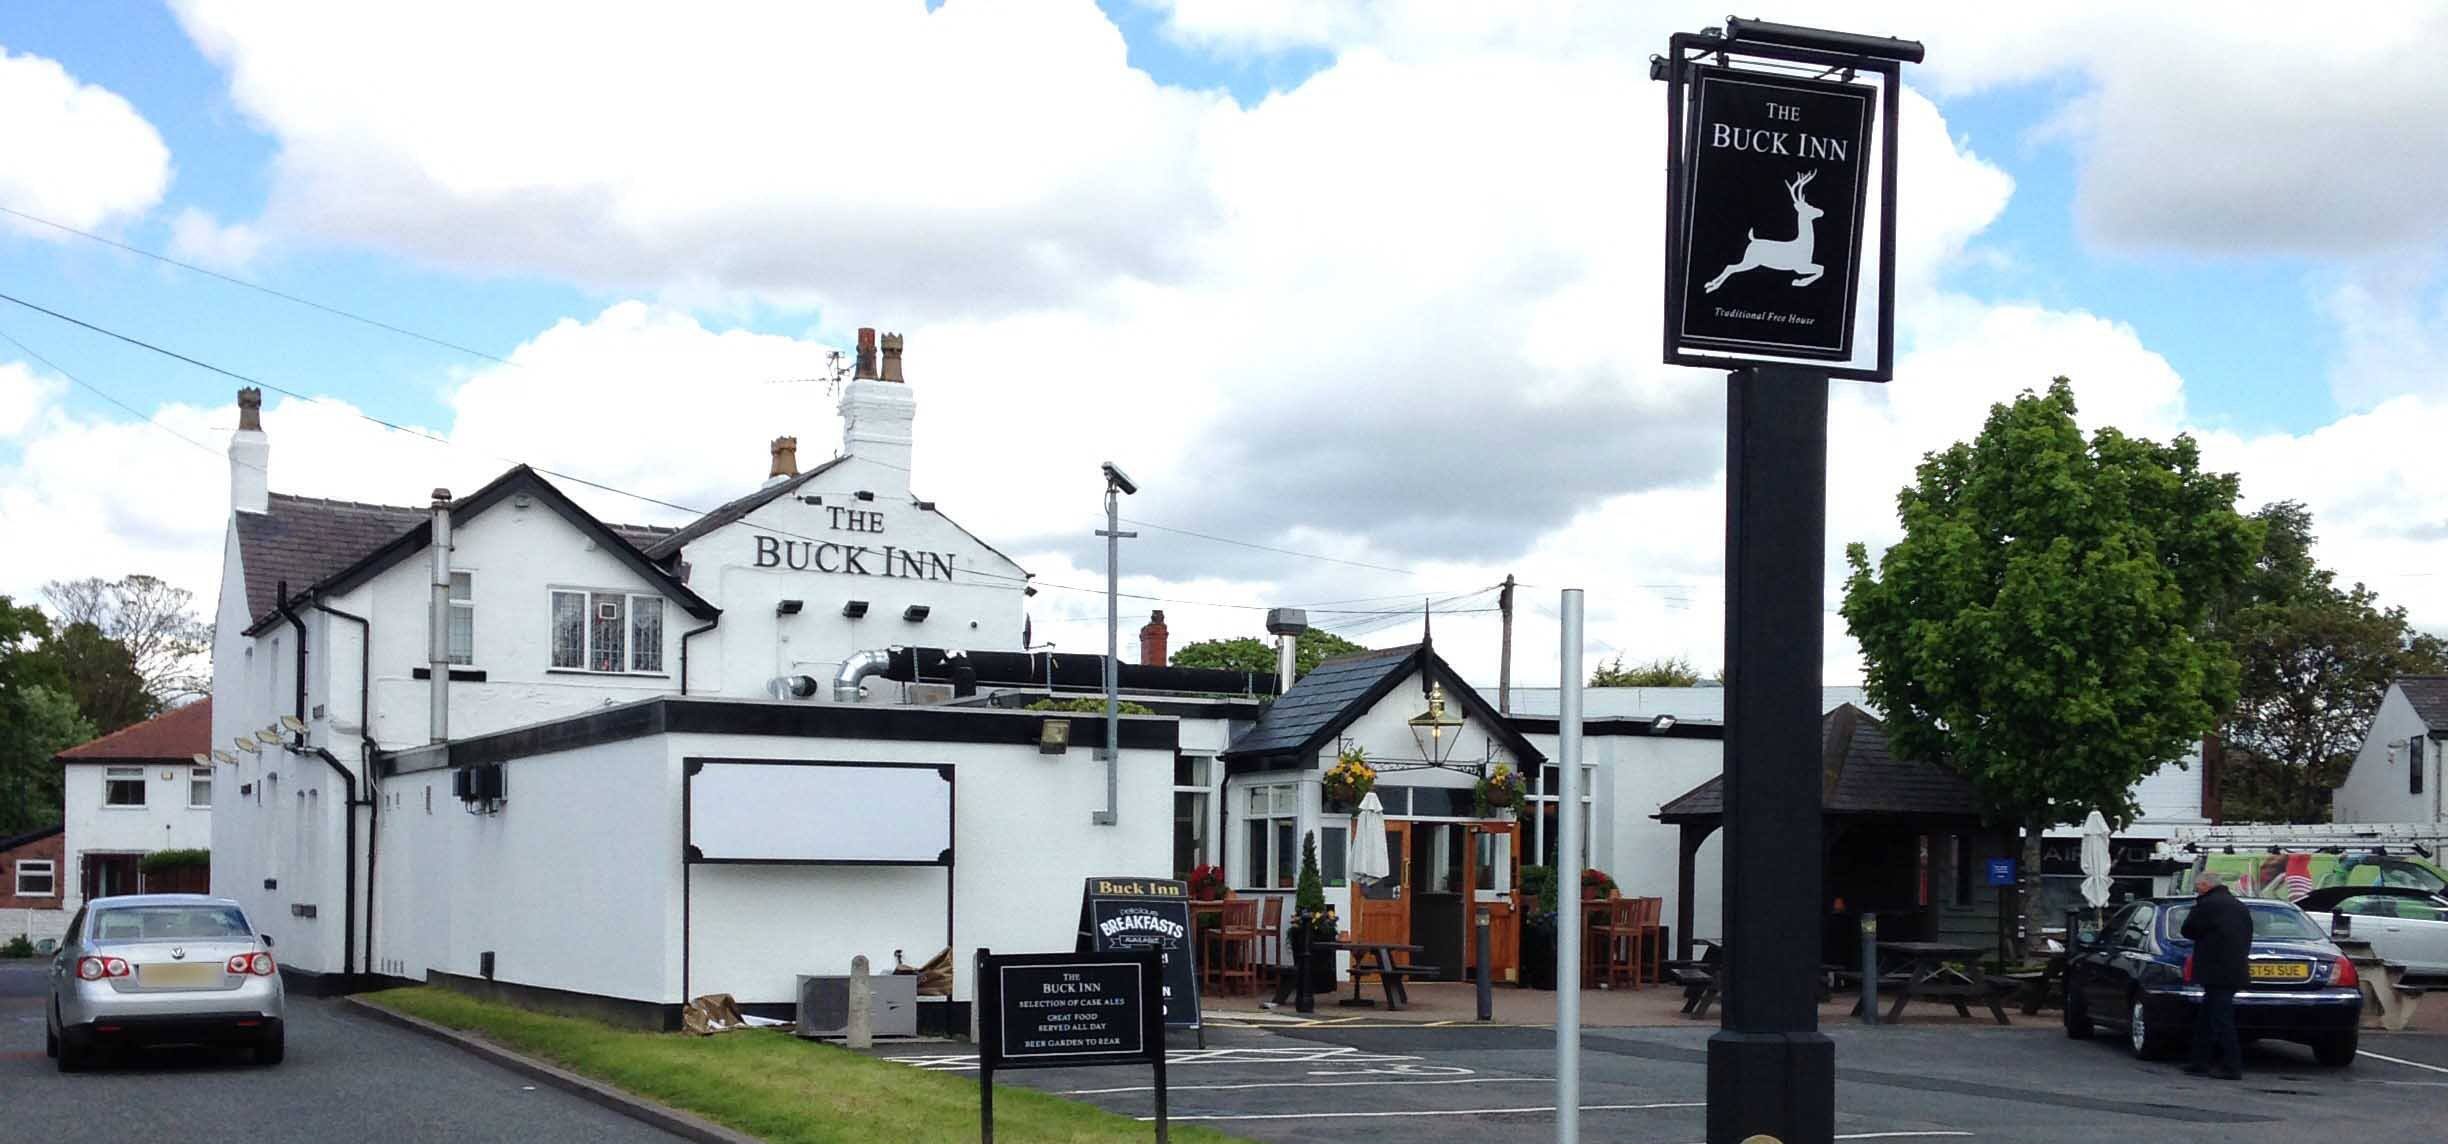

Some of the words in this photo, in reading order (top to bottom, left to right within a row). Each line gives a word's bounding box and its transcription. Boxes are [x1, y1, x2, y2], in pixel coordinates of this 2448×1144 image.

[1766, 102, 1800, 122] THE
[1712, 123, 1791, 157] BUCK
[1797, 133, 1848, 161] INN
[1715, 307, 1765, 320] Traditional
[1767, 312, 1786, 322] Free
[1788, 314, 1815, 325] House
[826, 505, 885, 534] THE
[753, 535, 870, 576] BUCK
[882, 545, 956, 582] INN
[1100, 881, 1145, 895] Buck
[1150, 882, 1180, 896] Inn
[1100, 915, 1184, 939] BREAKFASTS
[1063, 973, 1080, 981] THE
[1043, 983, 1075, 994] BUCK
[1079, 982, 1101, 993] INN
[1019, 1000, 1066, 1008] SELECTION
[1103, 998, 1125, 1006] ALES
[1038, 1024, 1070, 1032] SERVED
[1072, 1023, 1088, 1031] ALL
[1024, 1040, 1046, 1048] BEER
[1047, 1039, 1084, 1047] GARDEN
[1085, 1038, 1097, 1046] TO
[1098, 1037, 1120, 1045] REAR
